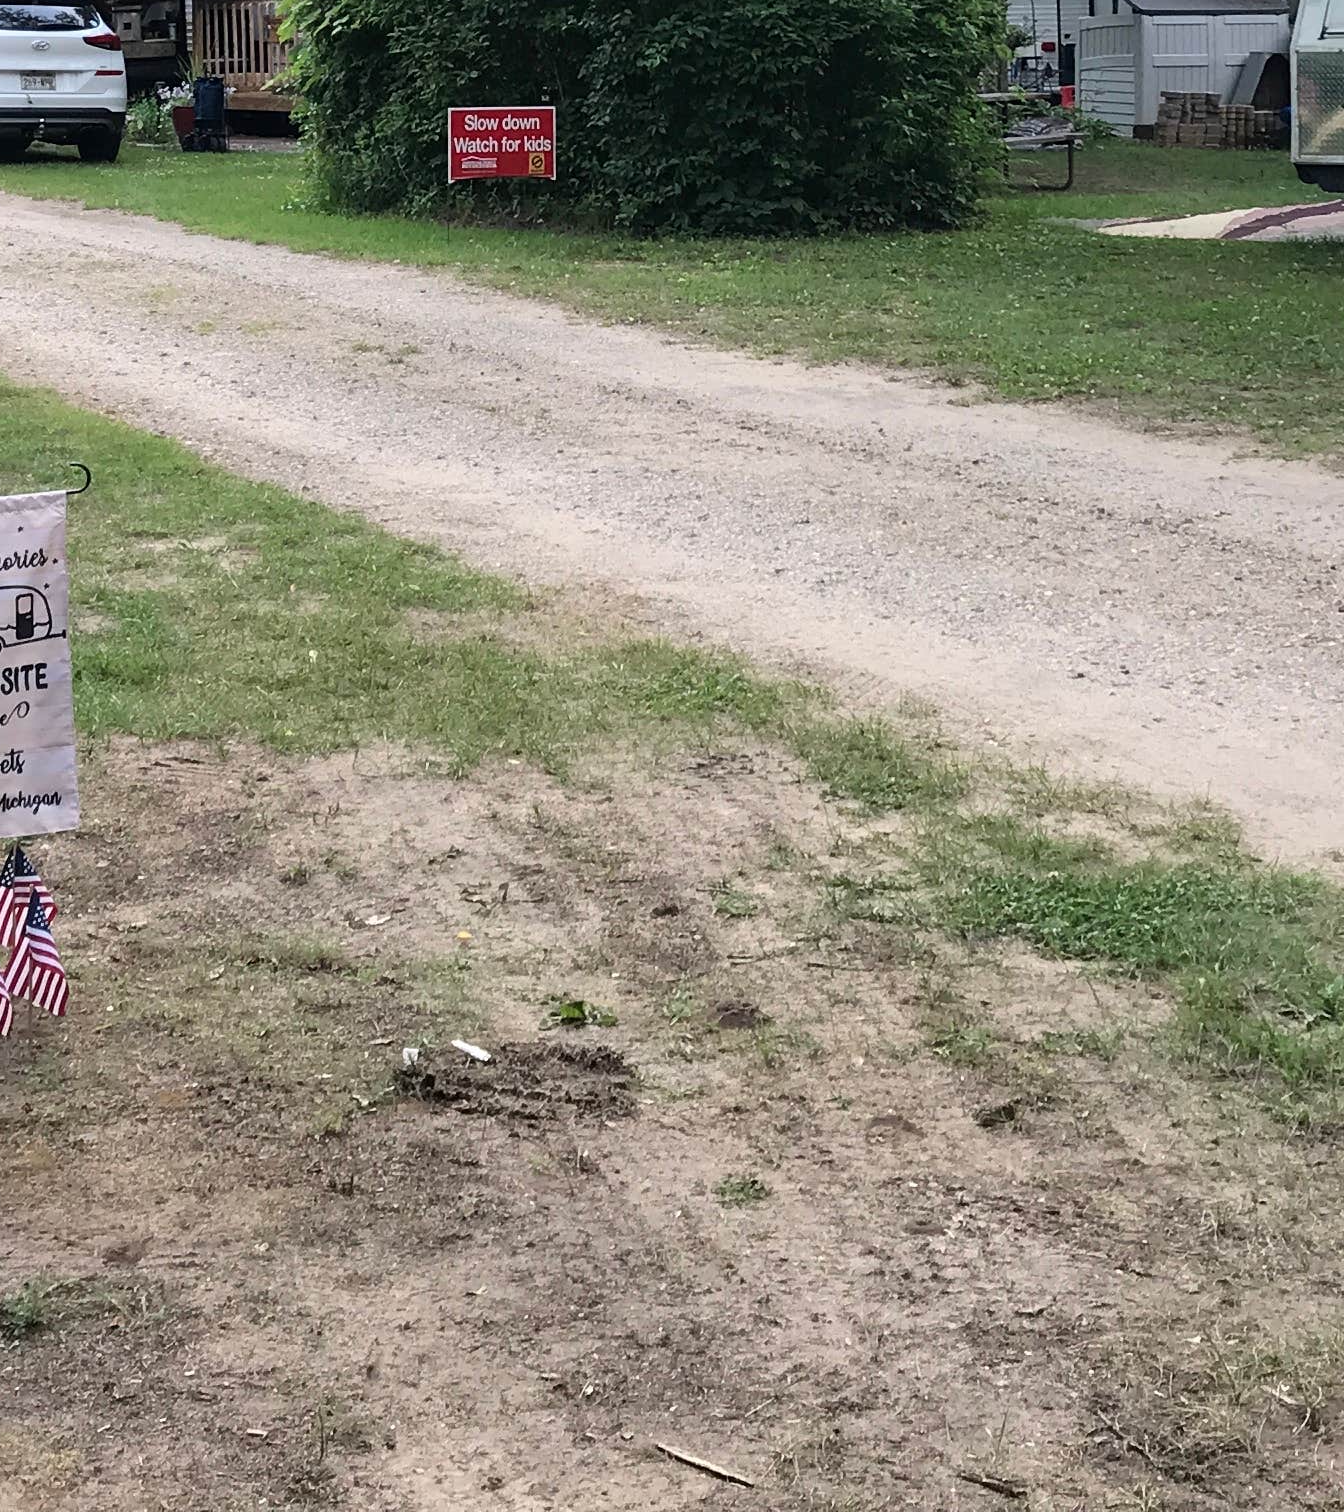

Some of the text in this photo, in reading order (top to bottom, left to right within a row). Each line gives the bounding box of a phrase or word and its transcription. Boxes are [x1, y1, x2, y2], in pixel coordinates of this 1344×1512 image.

[464, 114, 541, 132] Slow down
[454, 136, 552, 154] Watch for kids
